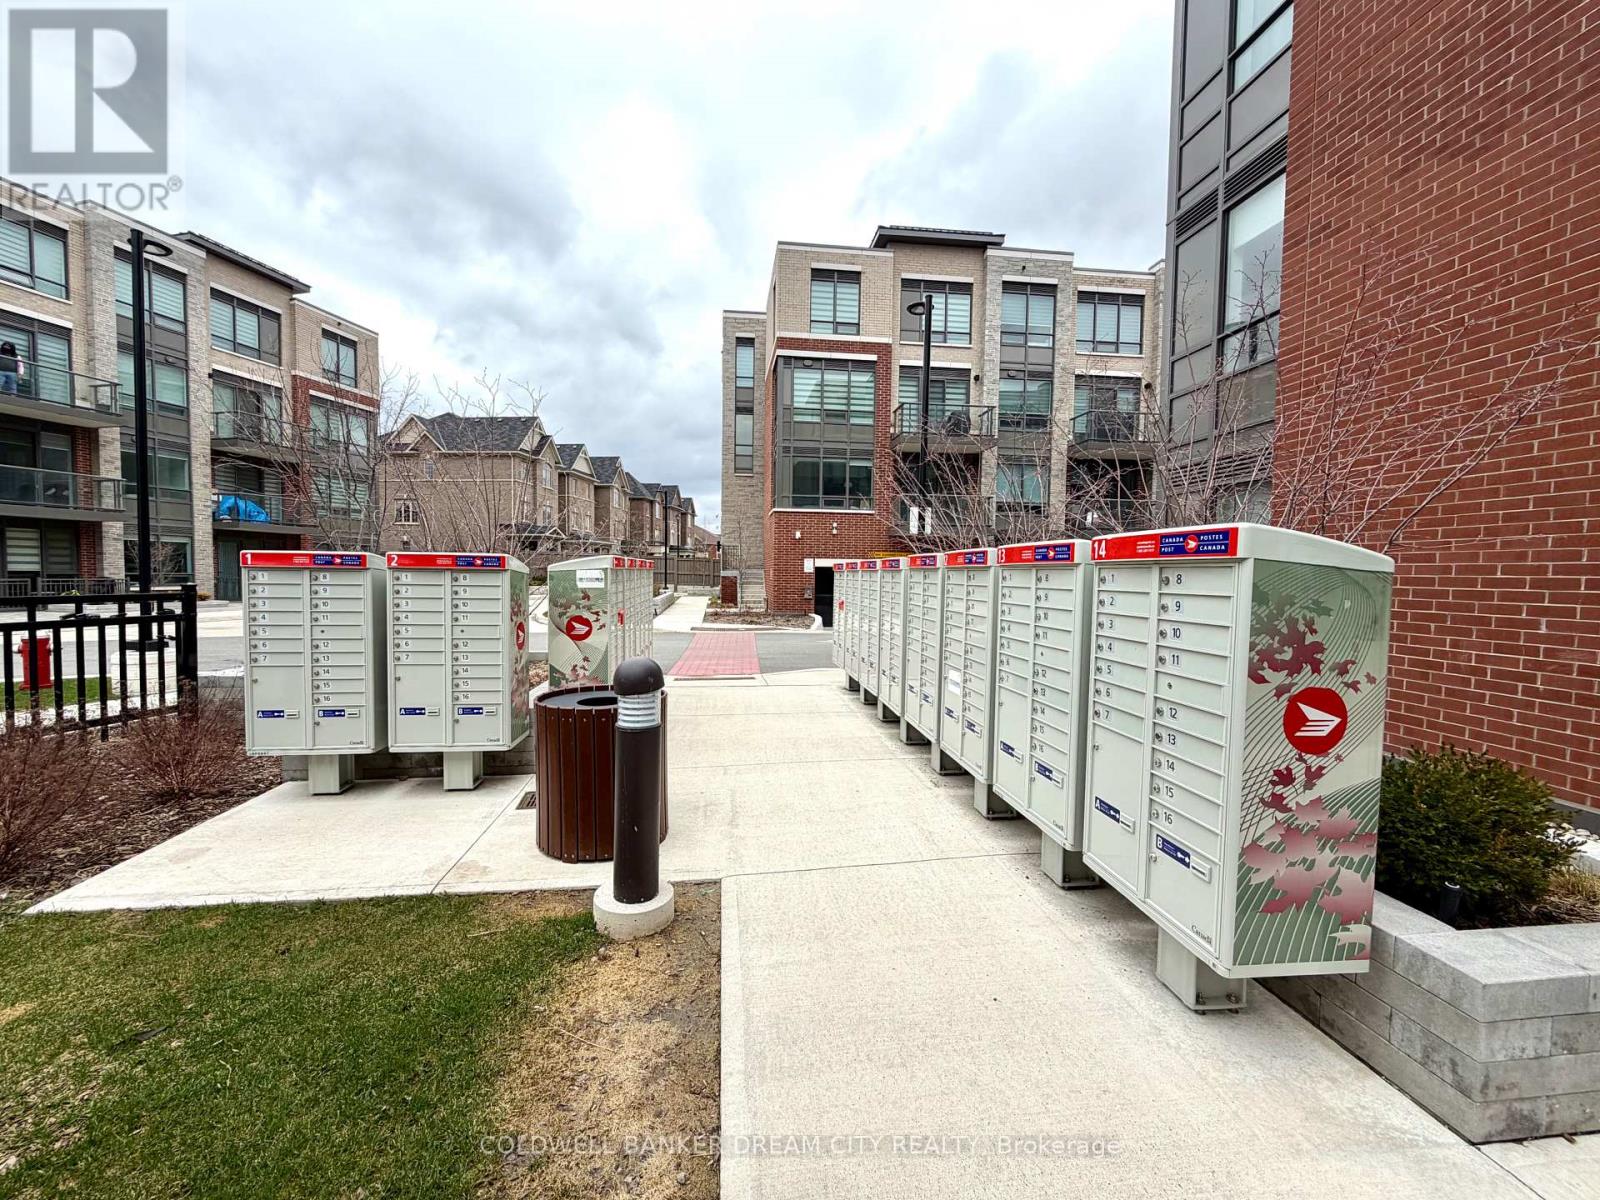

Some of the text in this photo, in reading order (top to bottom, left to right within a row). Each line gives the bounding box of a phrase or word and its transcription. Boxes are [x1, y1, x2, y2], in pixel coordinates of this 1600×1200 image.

[1161, 536, 1184, 544] CANADA
[1093, 539, 1107, 559] 14
[244, 553, 252, 565] 1
[390, 554, 398, 566] 2
[1176, 573, 1182, 585] 8
[1109, 596, 1115, 606] 2
[1175, 601, 1181, 612] 9
[1108, 620, 1114, 629] 3
[1172, 627, 1181, 639] 10
[1107, 642, 1113, 651] 4
[1171, 654, 1180, 665] 11
[1041, 669, 1047, 679] 12
[1106, 665, 1112, 674] 5
[1105, 688, 1111, 697] 6
[1104, 710, 1110, 719] 7
[1169, 707, 1178, 719] 12
[1167, 733, 1177, 746] 13
[1166, 759, 1175, 772] 14
[1164, 785, 1174, 798] 15
[1095, 798, 1100, 808] A
[1163, 811, 1173, 825] 16
[1157, 836, 1163, 848] B
